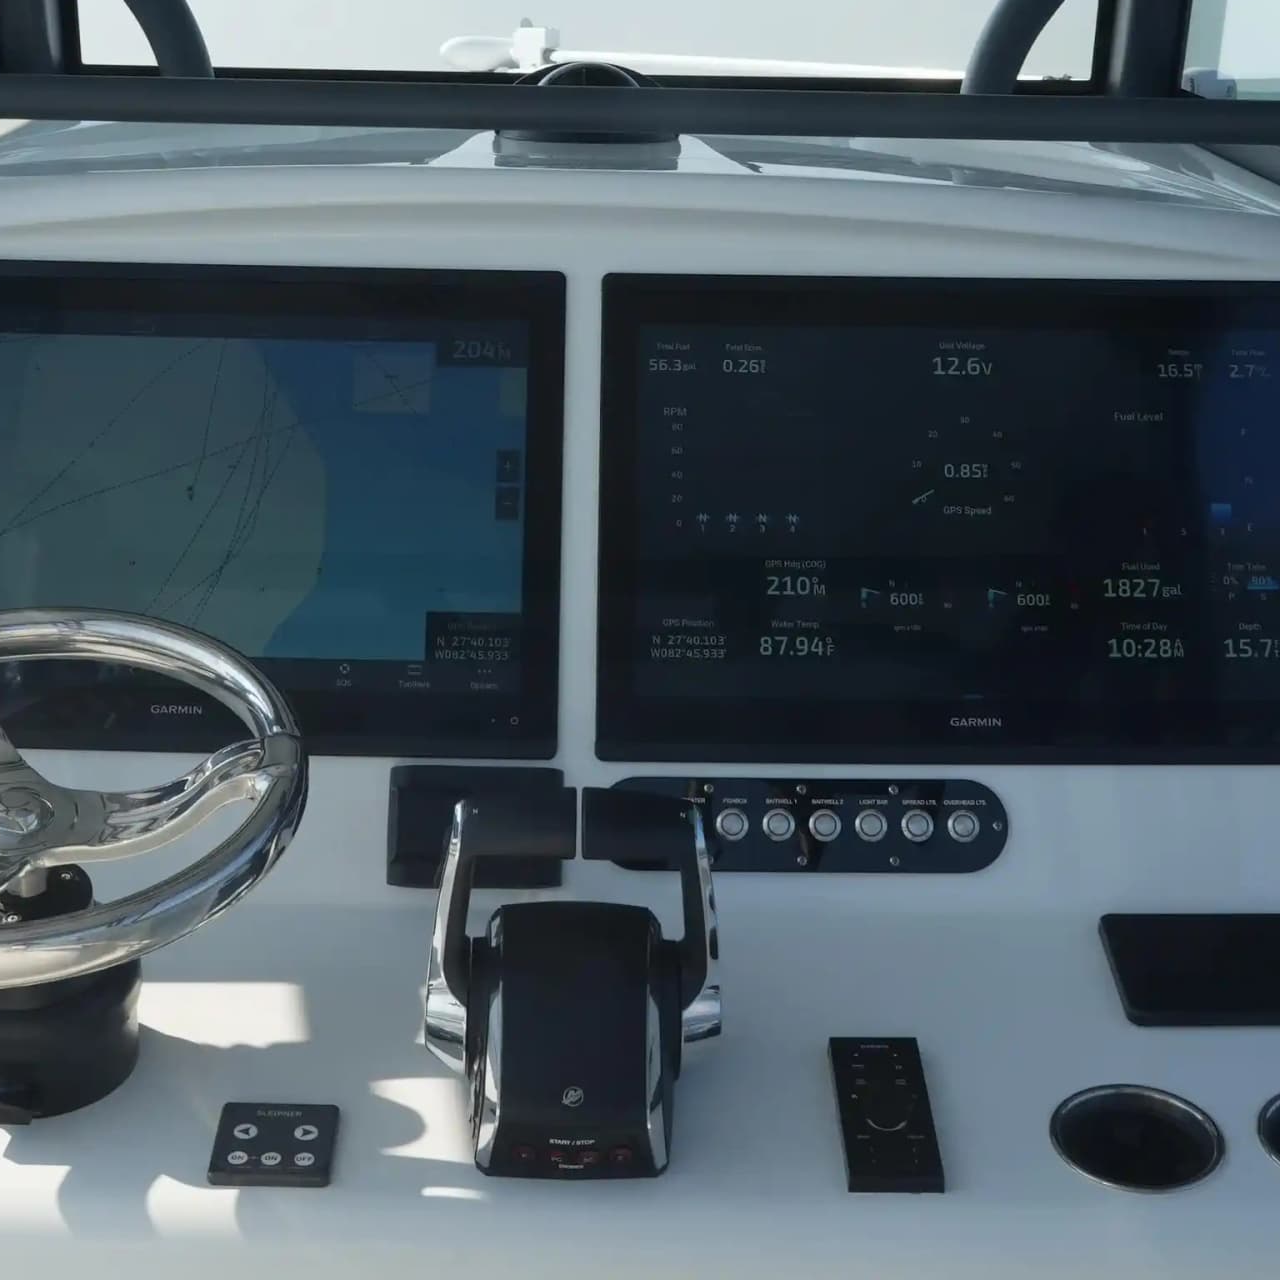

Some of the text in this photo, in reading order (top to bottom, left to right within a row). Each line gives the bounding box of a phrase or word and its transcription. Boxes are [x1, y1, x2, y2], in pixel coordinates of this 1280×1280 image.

[1113, 410, 1164, 422] Fuel Level
[150, 704, 203, 715] GARMIN
[950, 717, 1002, 728] GARMIN
[264, 1154, 279, 1162] ON
